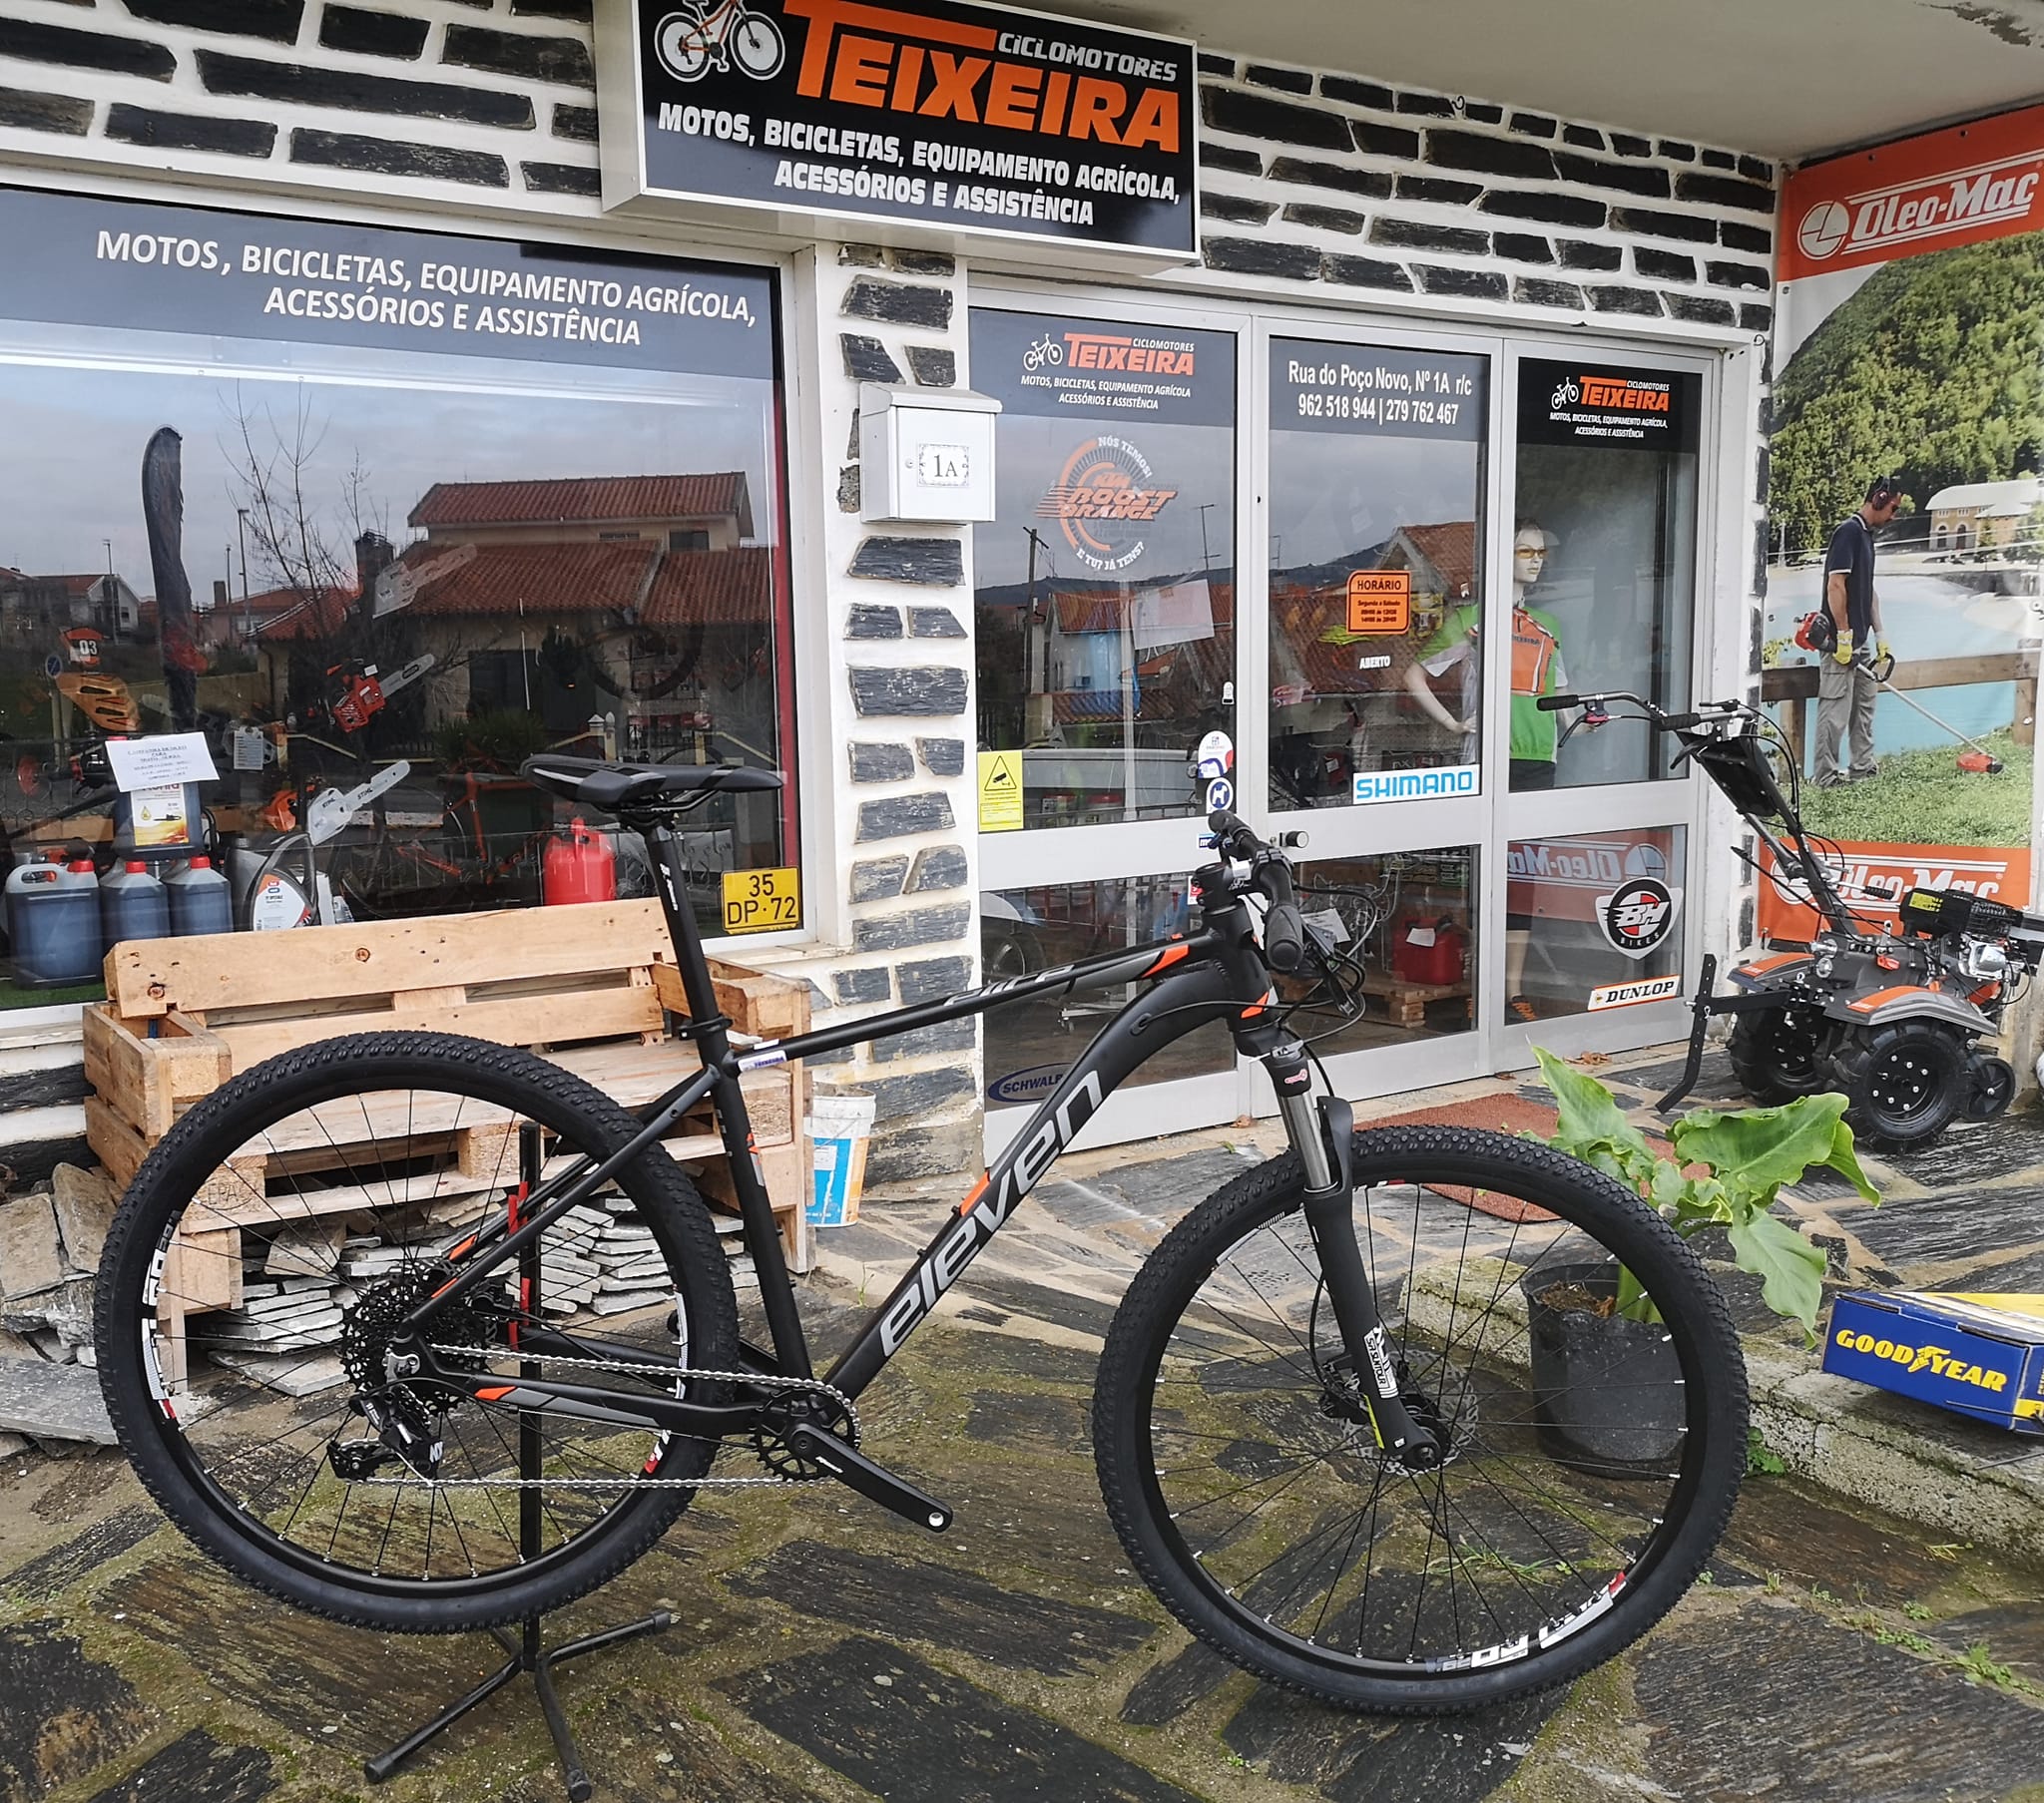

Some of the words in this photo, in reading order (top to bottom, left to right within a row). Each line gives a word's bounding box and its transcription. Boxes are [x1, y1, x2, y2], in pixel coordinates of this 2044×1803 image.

[998, 32, 1177, 82] CICLOMOTORES
[782, 0, 1180, 153] TEIXEIRA
[658, 102, 756, 148] MOTOS,
[764, 119, 905, 168] BICICLETAS,
[912, 141, 1070, 186] EQUIPAMENTO
[1075, 161, 1181, 206] AGRÍCOLA,
[773, 161, 925, 207] ACESSÓRIOS
[931, 182, 947, 207] E
[952, 187, 1094, 226] ASSISTÊNCIA
[1850, 173, 2040, 241] Oleo-Mac
[96, 230, 232, 276] MOTOS,
[242, 245, 411, 292] BICICLETAS,
[419, 263, 621, 308] EQUIPAMENTO
[625, 282, 757, 327] AGRÍCOLA,
[263, 285, 444, 329] ACESSÓRIOS
[452, 305, 468, 330] E
[475, 306, 641, 346] ASSISTÊNCIA
[1064, 332, 1195, 376] TEIXEIRA
[1133, 338, 1195, 352] CICLOMOTORES
[1021, 375, 1053, 388] MOTOS,
[1054, 377, 1097, 391] BICICLETAS,
[1098, 381, 1154, 395] EQUIPAMENTO
[1288, 360, 1315, 385] Rua
[1318, 363, 1337, 386] do
[1340, 365, 1373, 393] Poço
[1375, 368, 1412, 393] Novo,
[1433, 373, 1450, 394] 1A
[1455, 375, 1472, 396] r/c
[1626, 380, 1670, 392] CICLOMOTORES
[1058, 392, 1106, 406] ACESSÓRIOS
[1106, 396, 1112, 406] E
[1112, 395, 1159, 409] ASSISTÊNCIA
[1579, 375, 1670, 412] TEIXEIRA
[1297, 393, 1323, 417] 962
[1325, 395, 1350, 418] 518
[1351, 397, 1376, 420] 944
[1385, 400, 1410, 421] 279
[1412, 401, 1435, 424] 762
[1436, 403, 1458, 425] 467
[1098, 436, 1120, 448] NÓS
[934, 454, 958, 477] 1A
[1058, 504, 1162, 521] ORANGE
[1357, 578, 1401, 591] HORÁRIO
[79, 640, 98, 656] 03
[1359, 656, 1391, 670] ABERTO
[1356, 771, 1472, 799] SHIMANO
[749, 873, 774, 897] 35
[1615, 901, 1670, 928] BH
[1620, 931, 1660, 948] BIKES
[1605, 981, 1675, 1004] DUNLOP
[878, 1069, 1104, 1359] eleven
